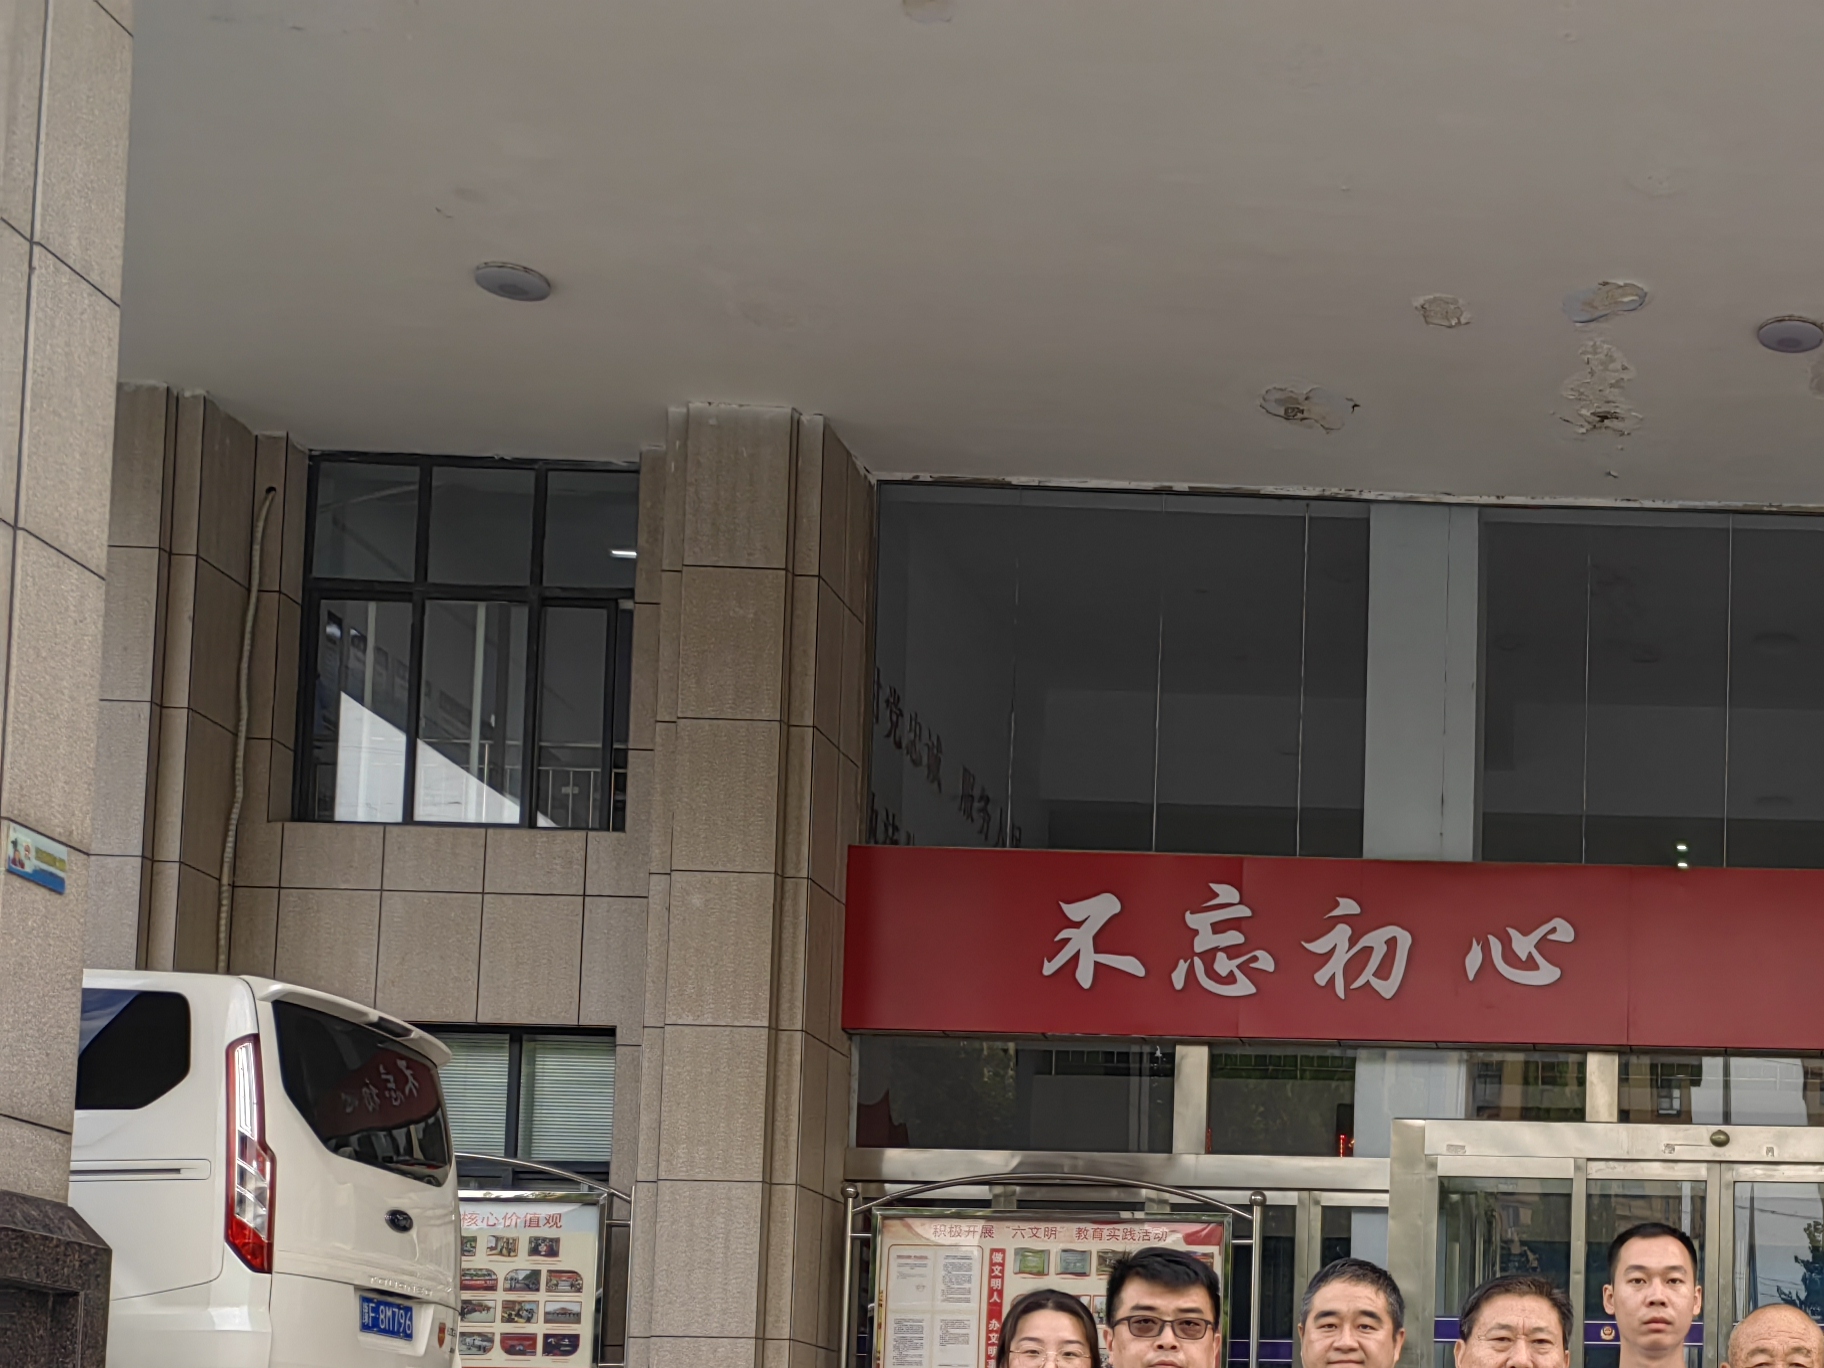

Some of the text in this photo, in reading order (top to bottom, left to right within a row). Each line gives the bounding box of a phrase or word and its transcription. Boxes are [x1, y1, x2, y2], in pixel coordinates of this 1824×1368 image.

[1042, 882, 1576, 1001] 不忘初心
[460, 1211, 563, 1229] 核心价值观
[932, 1223, 995, 1240] 积极开展
[1075, 1226, 1168, 1242] 教育实践活动
[989, 1251, 1003, 1303] 做文明人
